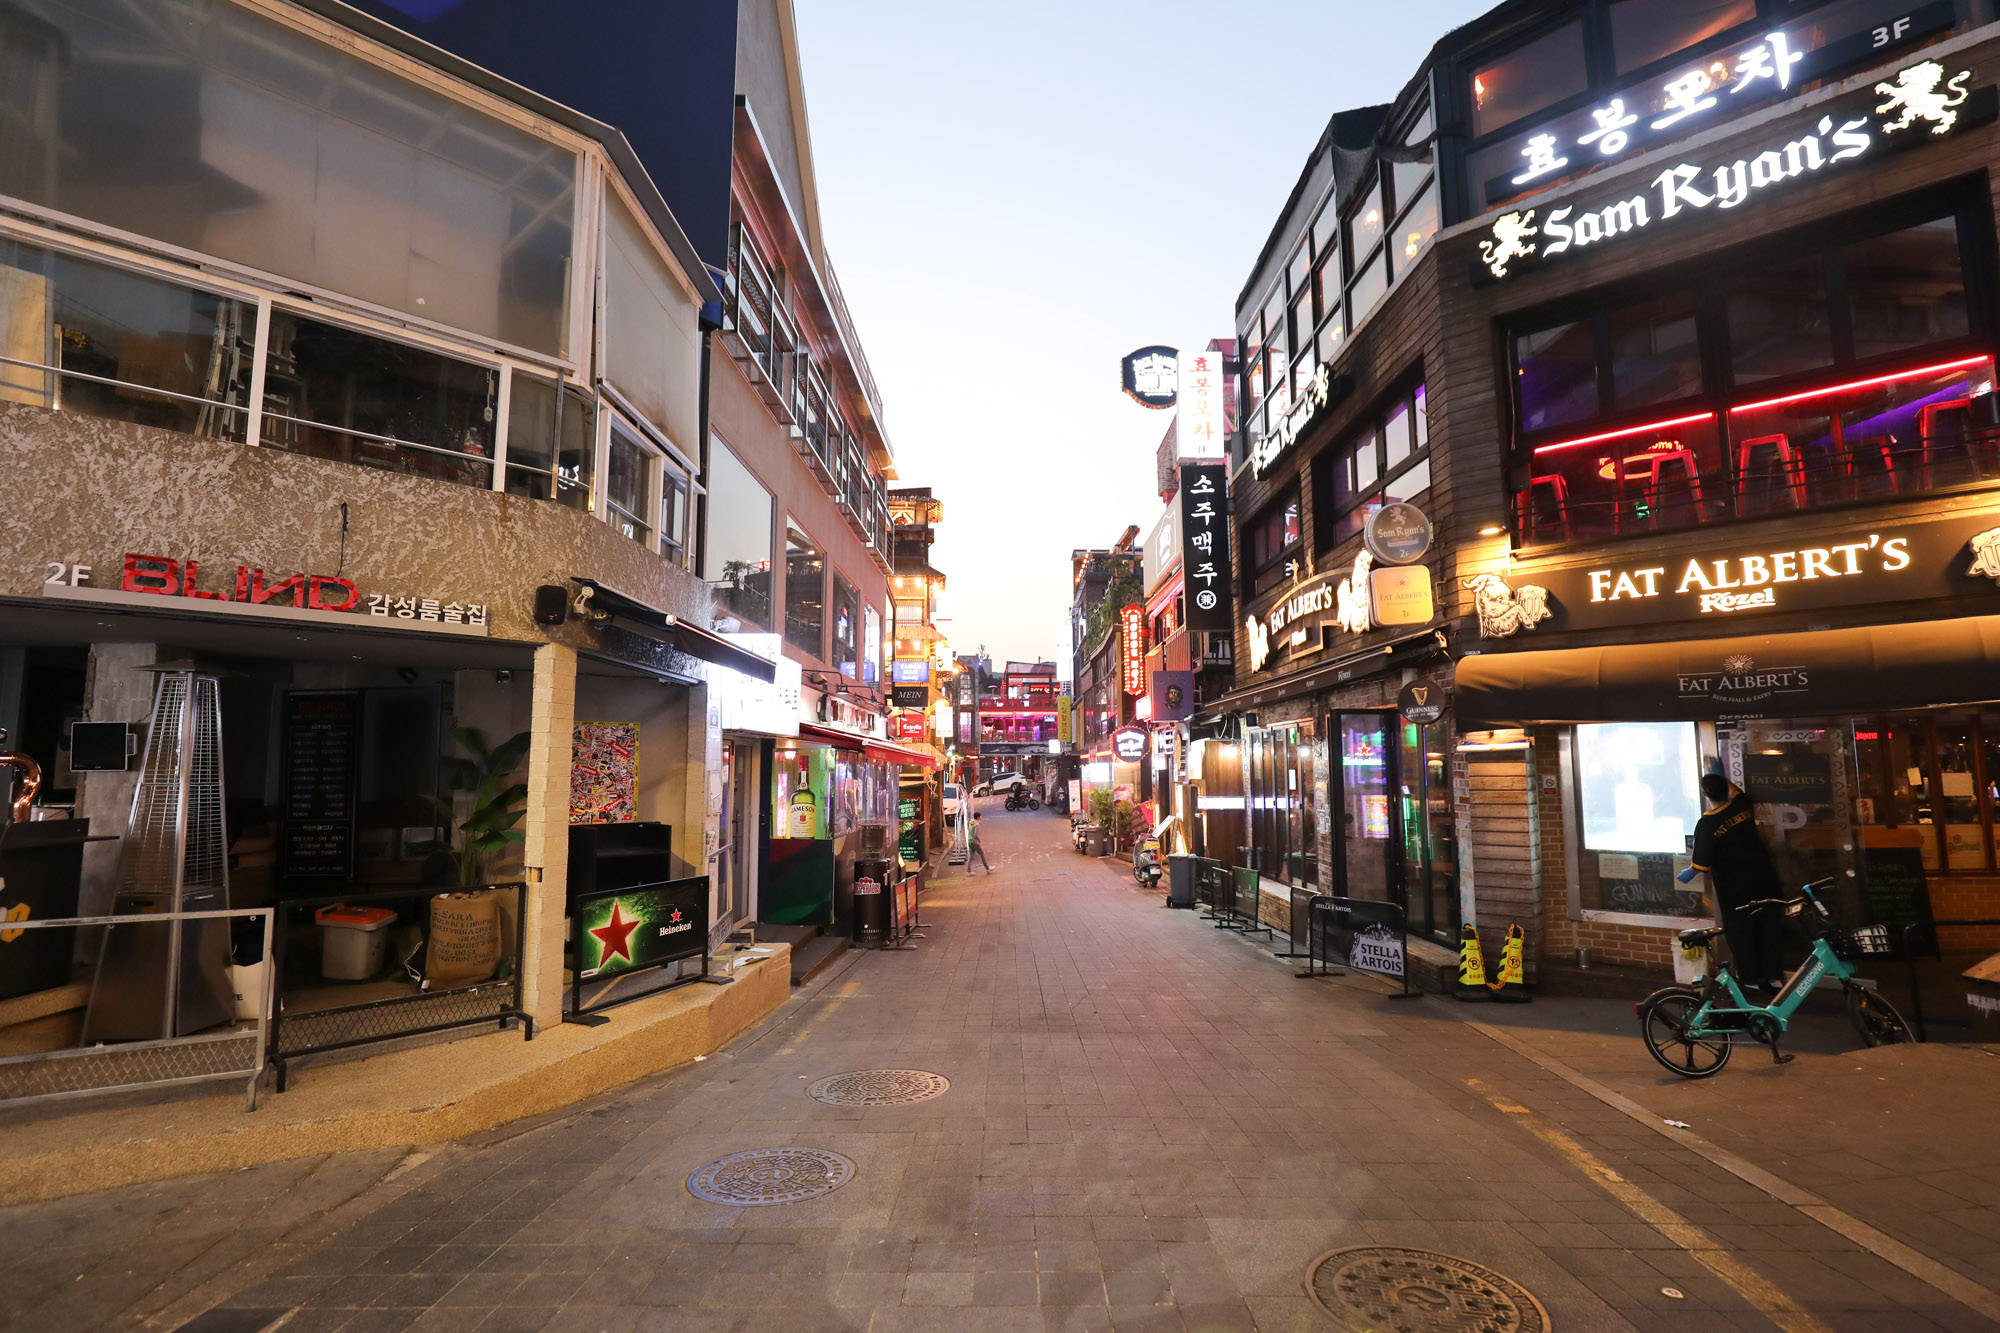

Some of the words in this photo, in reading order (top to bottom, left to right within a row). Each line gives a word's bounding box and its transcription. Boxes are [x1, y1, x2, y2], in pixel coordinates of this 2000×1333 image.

[1871, 17, 1911, 48] 3F
[1512, 31, 1803, 186] 효봉포차
[1541, 194, 1652, 259] Sam
[1651, 115, 1872, 223] Ryan's
[1190, 474, 1218, 587] 소주맥주
[1377, 528, 1396, 538] Sam
[1396, 525, 1425, 537] Ryan's
[1399, 549, 1409, 558] 2F
[44, 562, 92, 587] 2F
[1588, 567, 1664, 603] FAT
[1676, 535, 1910, 594] ALBERT'S
[121, 552, 360, 613] BLIND
[1380, 593, 1393, 601] FAT
[1396, 591, 1428, 600] ALBERT'S
[1700, 588, 1776, 613] Kozel
[367, 593, 488, 626] 감성룸술집
[1270, 606, 1286, 636] FAT
[1287, 582, 1333, 624] ALBERT'S
[1679, 677, 1712, 692] FAT
[1718, 670, 1808, 690] ALBERT'S
[898, 691, 922, 699] MEIN
[1712, 693, 1728, 702] BEER
[1406, 706, 1439, 714] GUINNESS
[1343, 755, 1383, 766] Heineken
[1751, 776, 1770, 785] FAT
[1774, 774, 1825, 785] ALBERT'S
[791, 805, 815, 814] JAMESON
[1315, 903, 1331, 911] STELLA
[1334, 904, 1352, 913] ARTOIS
[659, 921, 692, 937] Heineken
[1361, 943, 1401, 960] STELLA
[1361, 955, 1402, 973] ARTOIS
[1795, 962, 1825, 997] KICKGOING
